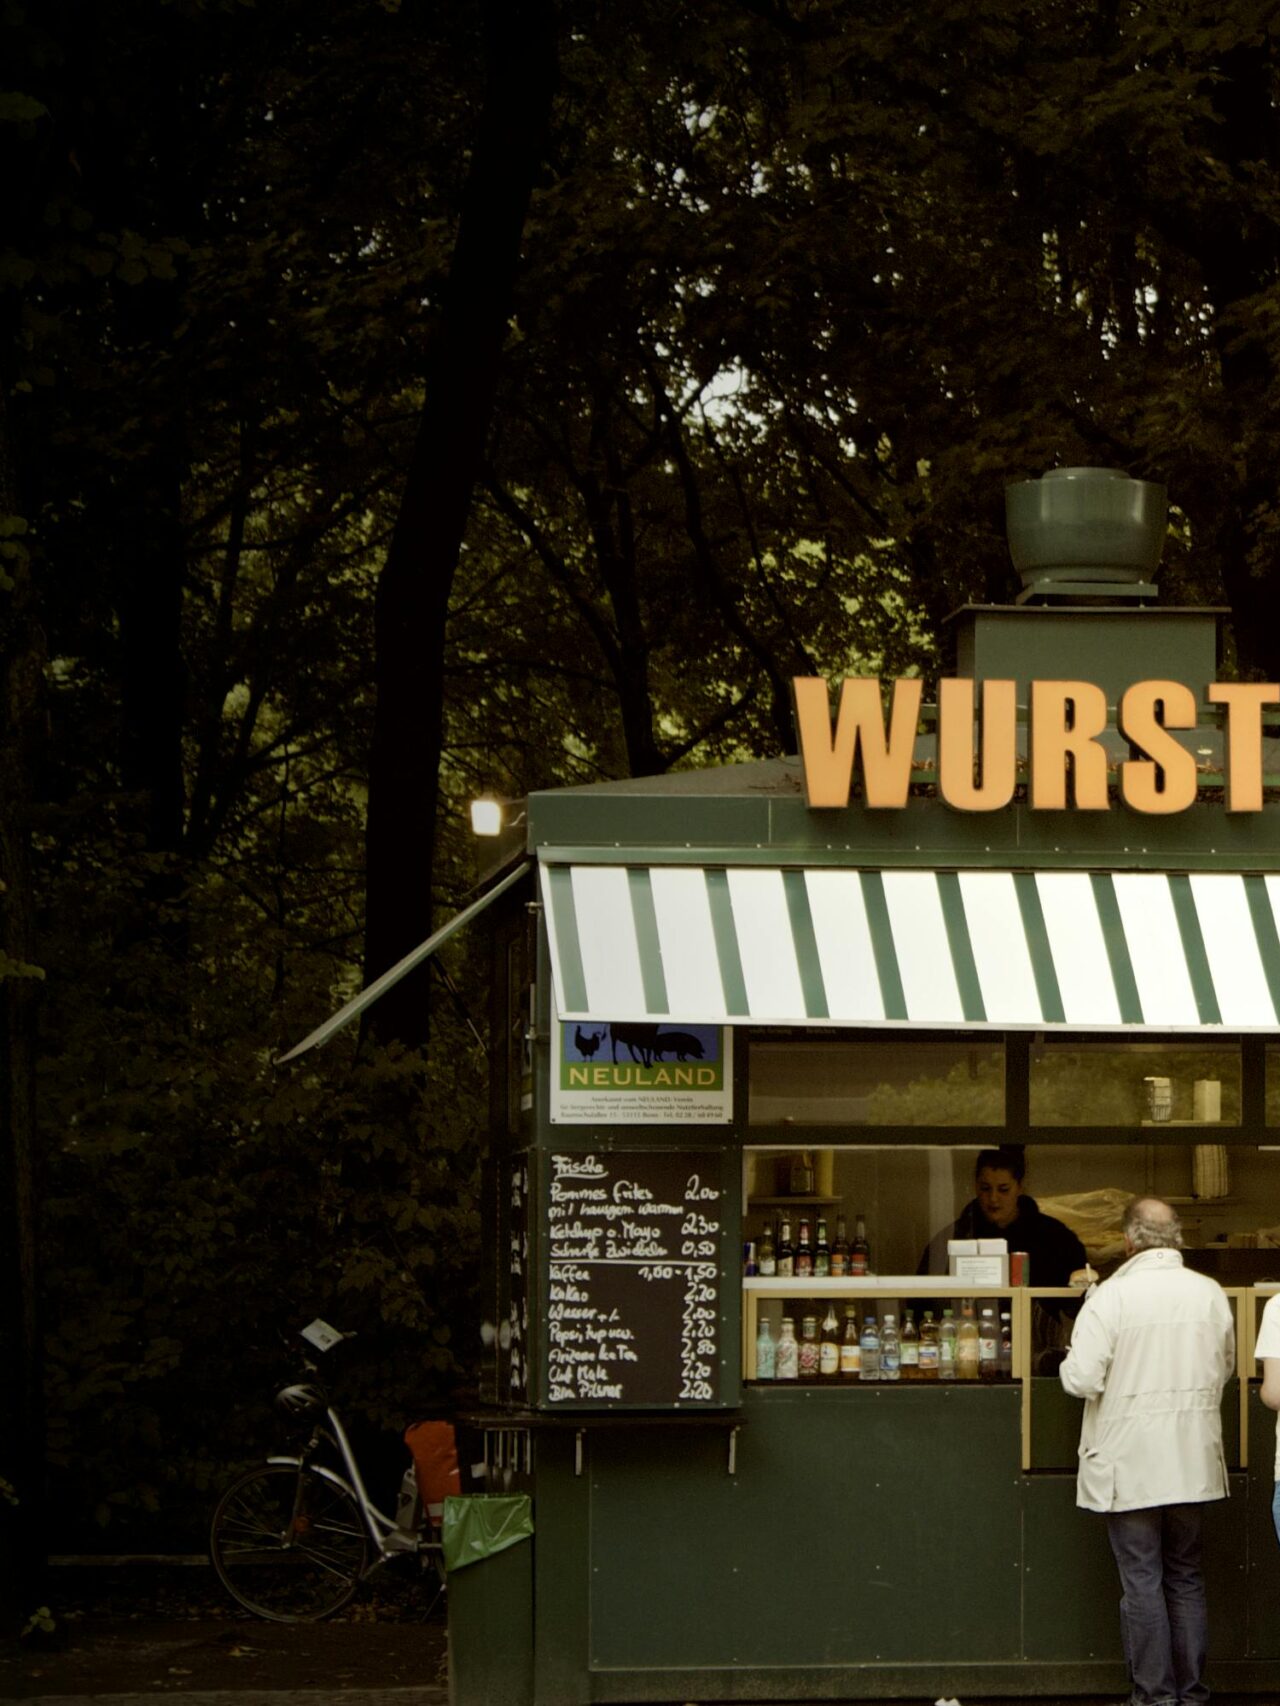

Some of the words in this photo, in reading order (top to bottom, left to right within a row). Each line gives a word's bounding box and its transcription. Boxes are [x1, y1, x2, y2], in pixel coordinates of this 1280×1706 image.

[792, 675, 1280, 815] WURST
[569, 1067, 716, 1086] NEULAND
[550, 1182, 608, 1203] Pommes
[550, 1221, 603, 1245] Ketchup
[621, 1220, 661, 1244] Mayo
[549, 1264, 591, 1282] Kaffee
[548, 1303, 598, 1320] Wasser
